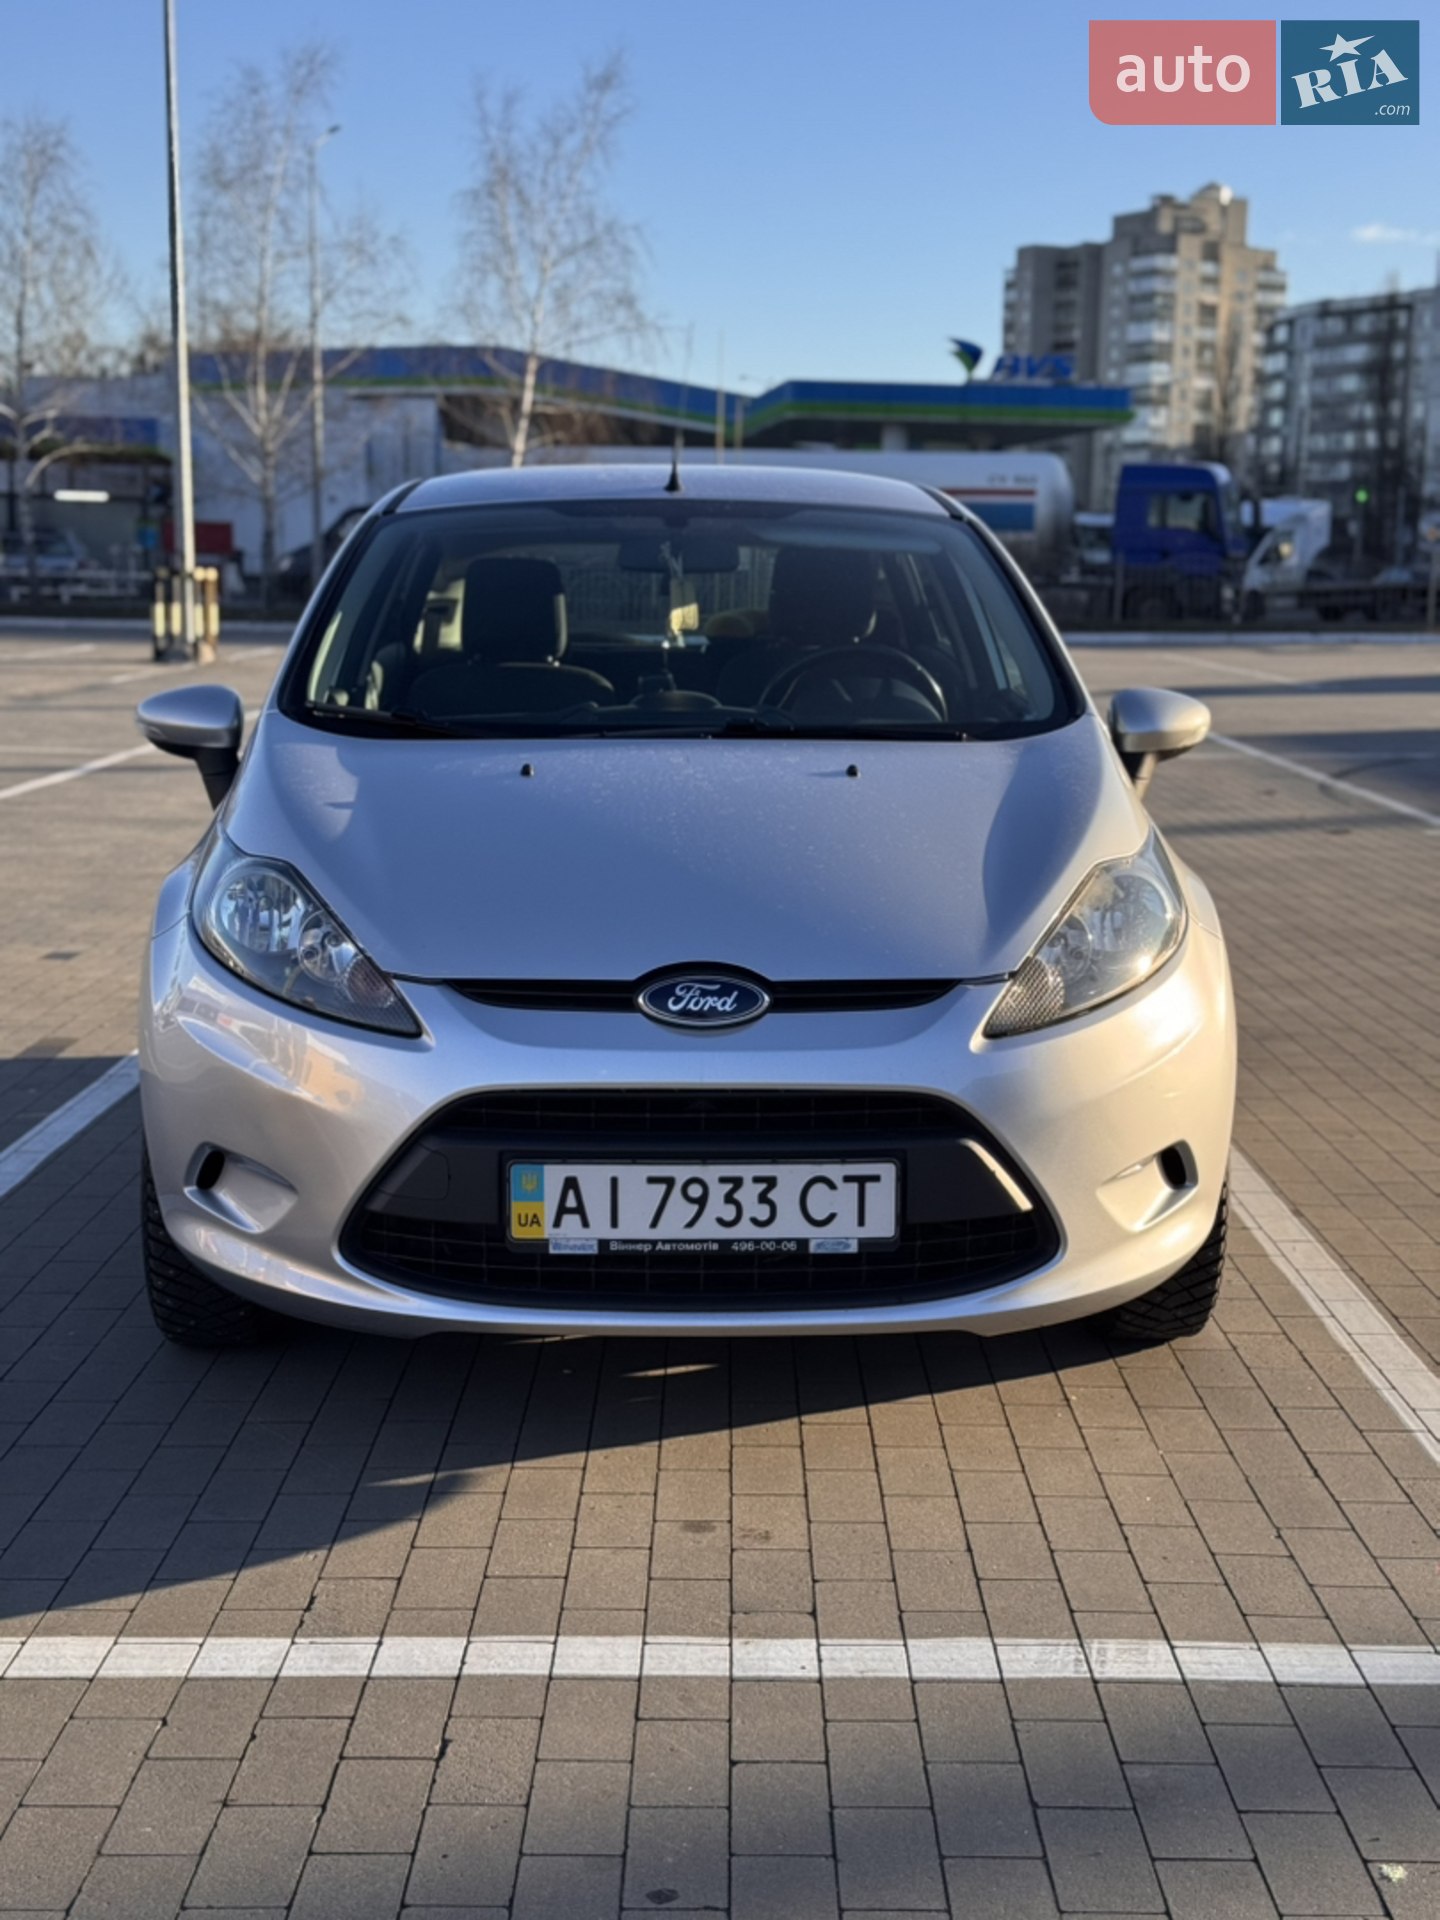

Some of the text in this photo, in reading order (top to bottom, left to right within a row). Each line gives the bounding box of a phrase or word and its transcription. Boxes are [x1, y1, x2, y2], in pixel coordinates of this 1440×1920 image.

[667, 982, 739, 1012] Ford
[646, 1176, 778, 1229] 7933
[800, 1174, 882, 1229] CT
[517, 1213, 541, 1227] UA
[655, 1240, 719, 1251] Автомотів
